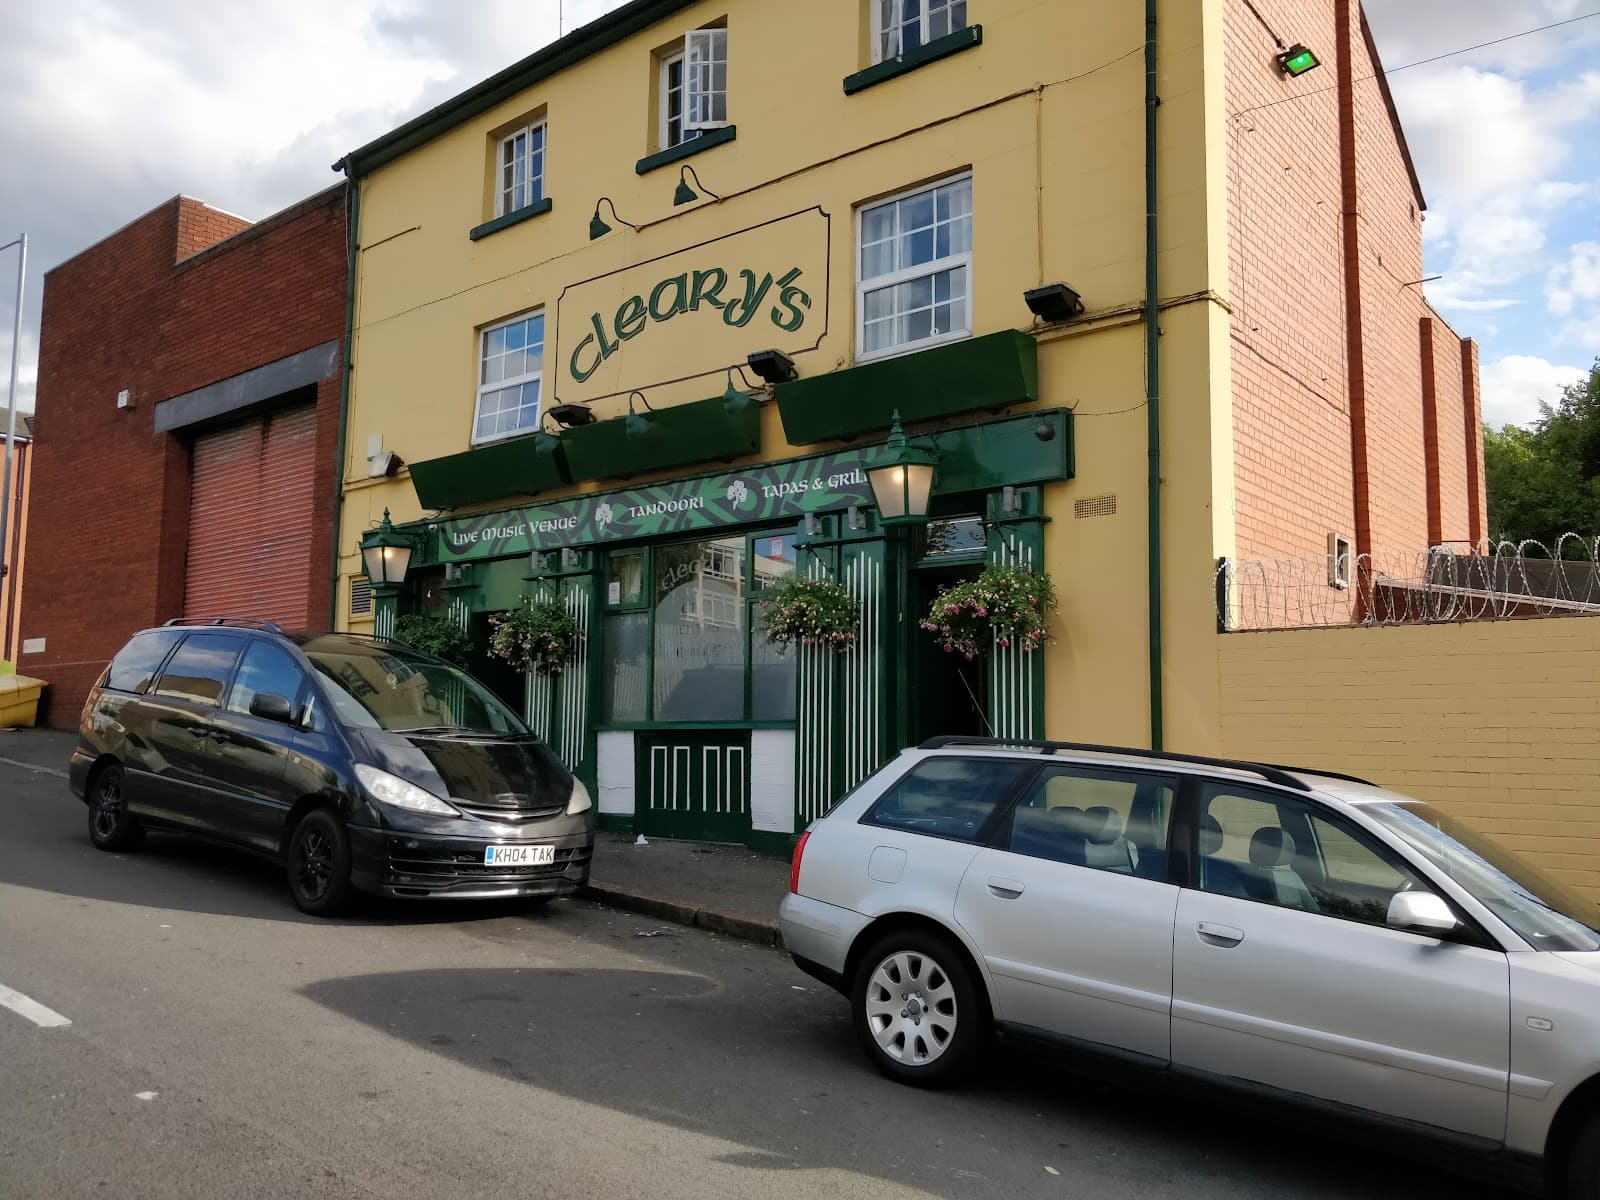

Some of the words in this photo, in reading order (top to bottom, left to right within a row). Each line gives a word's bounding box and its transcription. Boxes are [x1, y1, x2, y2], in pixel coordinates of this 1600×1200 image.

[761, 477, 808, 499] TAPAS
[811, 477, 824, 491] &
[629, 496, 705, 518] TANDOORI
[494, 847, 528, 863] KH04
[531, 846, 554, 863] TAK
